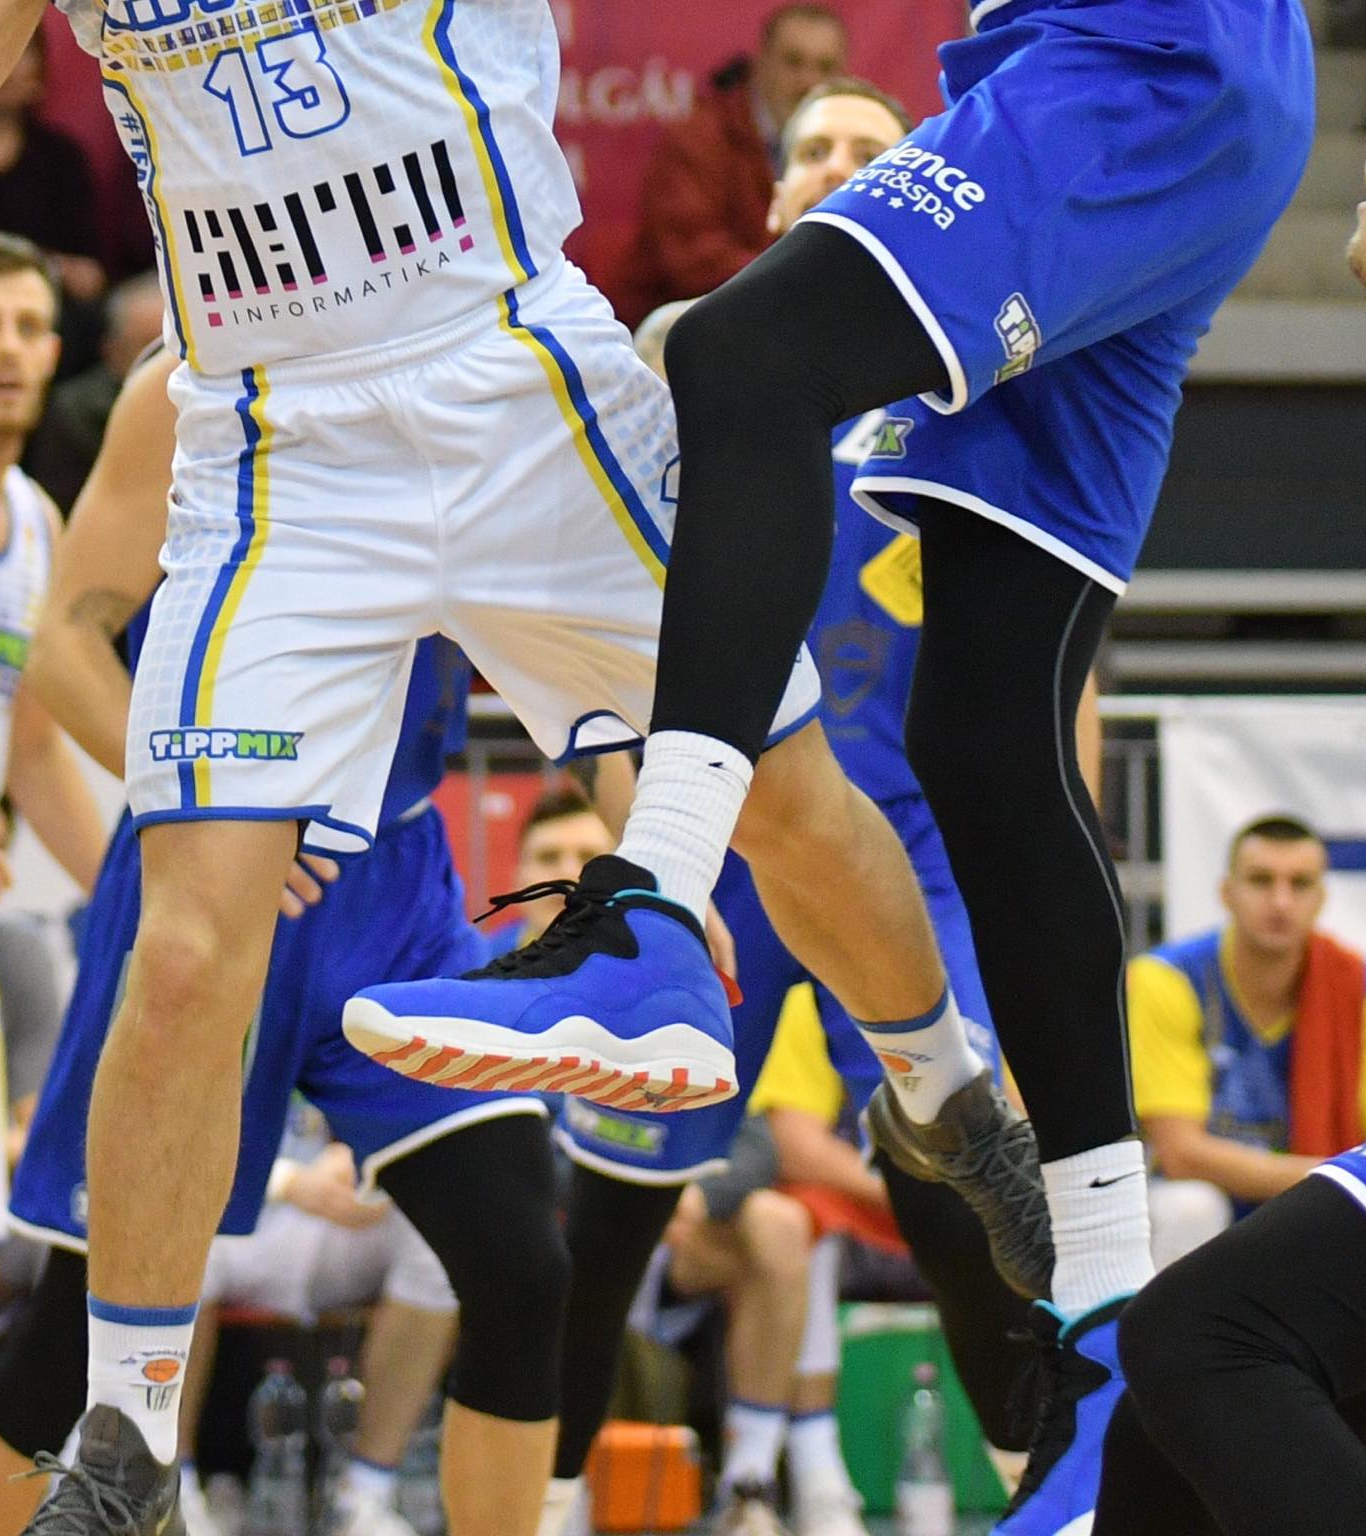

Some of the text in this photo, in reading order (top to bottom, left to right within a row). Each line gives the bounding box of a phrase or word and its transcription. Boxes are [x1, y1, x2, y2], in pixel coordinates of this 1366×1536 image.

[202, 29, 351, 158] 13
[232, 250, 451, 326] INFORMATIKA
[150, 729, 304, 760] TiPPMIX
